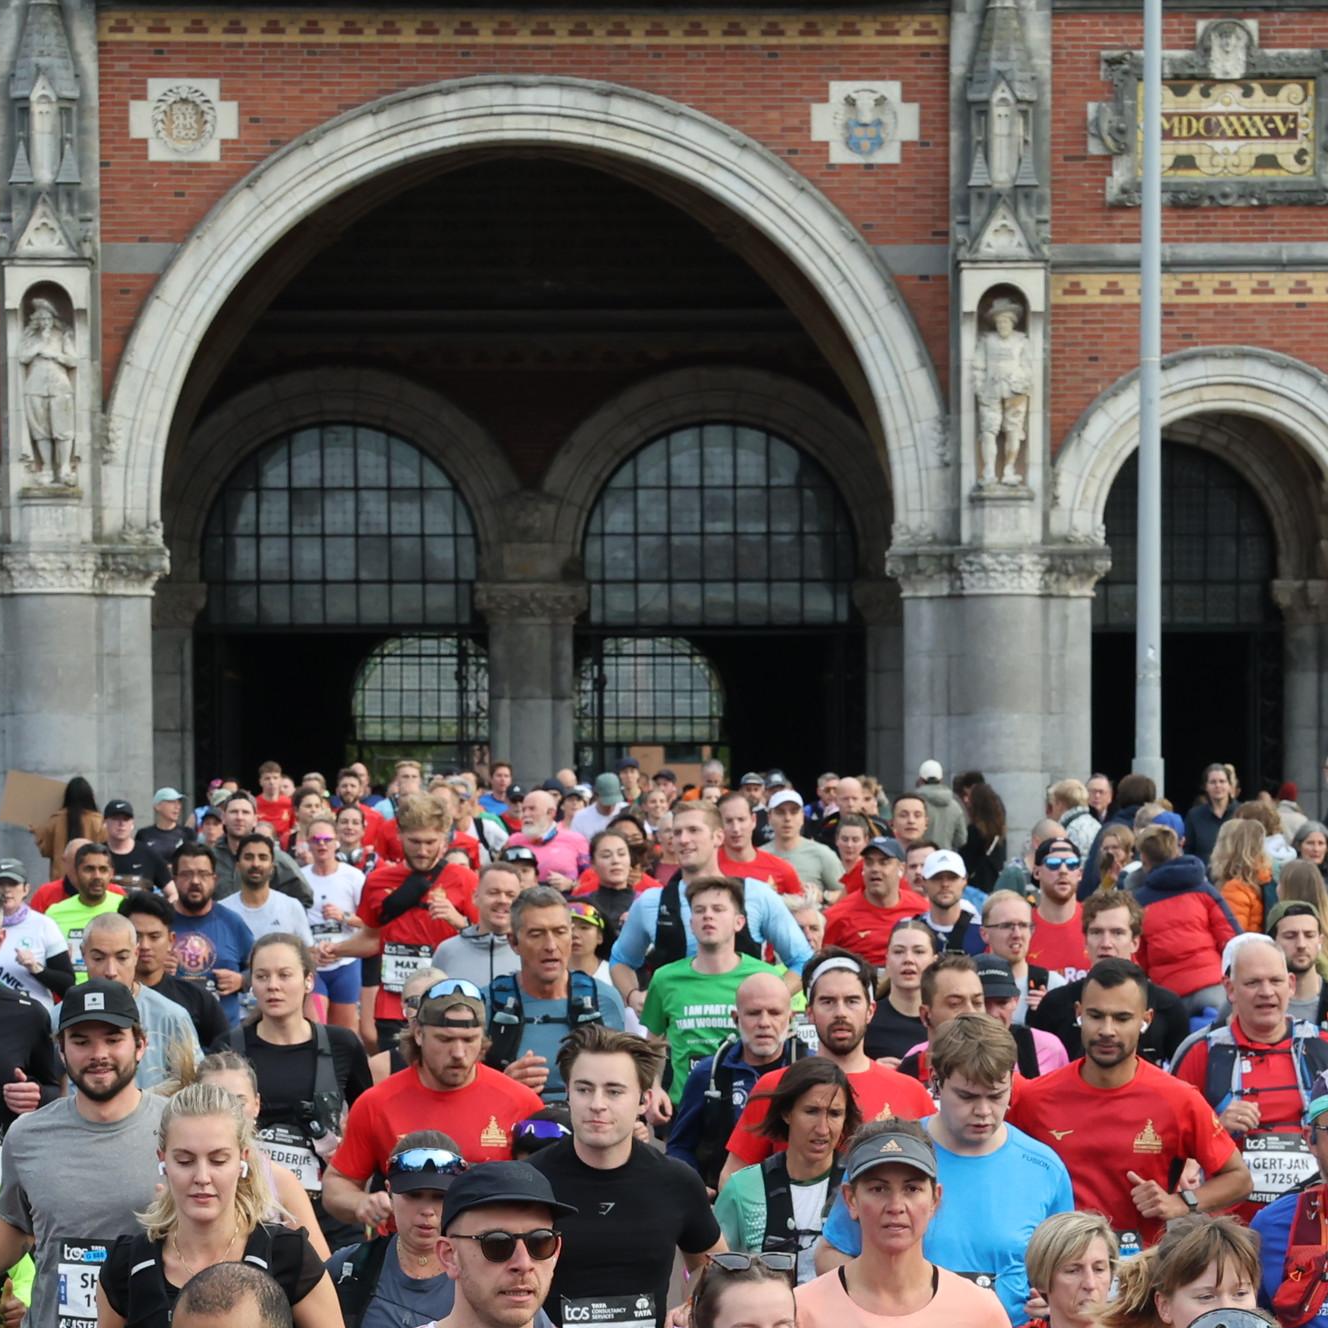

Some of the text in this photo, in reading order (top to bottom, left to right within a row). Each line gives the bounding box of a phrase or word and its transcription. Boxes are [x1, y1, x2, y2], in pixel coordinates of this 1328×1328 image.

[395, 960, 418, 970] MAX
[1246, 1138, 1266, 1150] tcs
[1253, 1157, 1310, 1171] GERT-JAN
[1264, 1173, 1300, 1186] 17256
[564, 1304, 590, 1321] tcs
[633, 1309, 652, 1318] TATA
